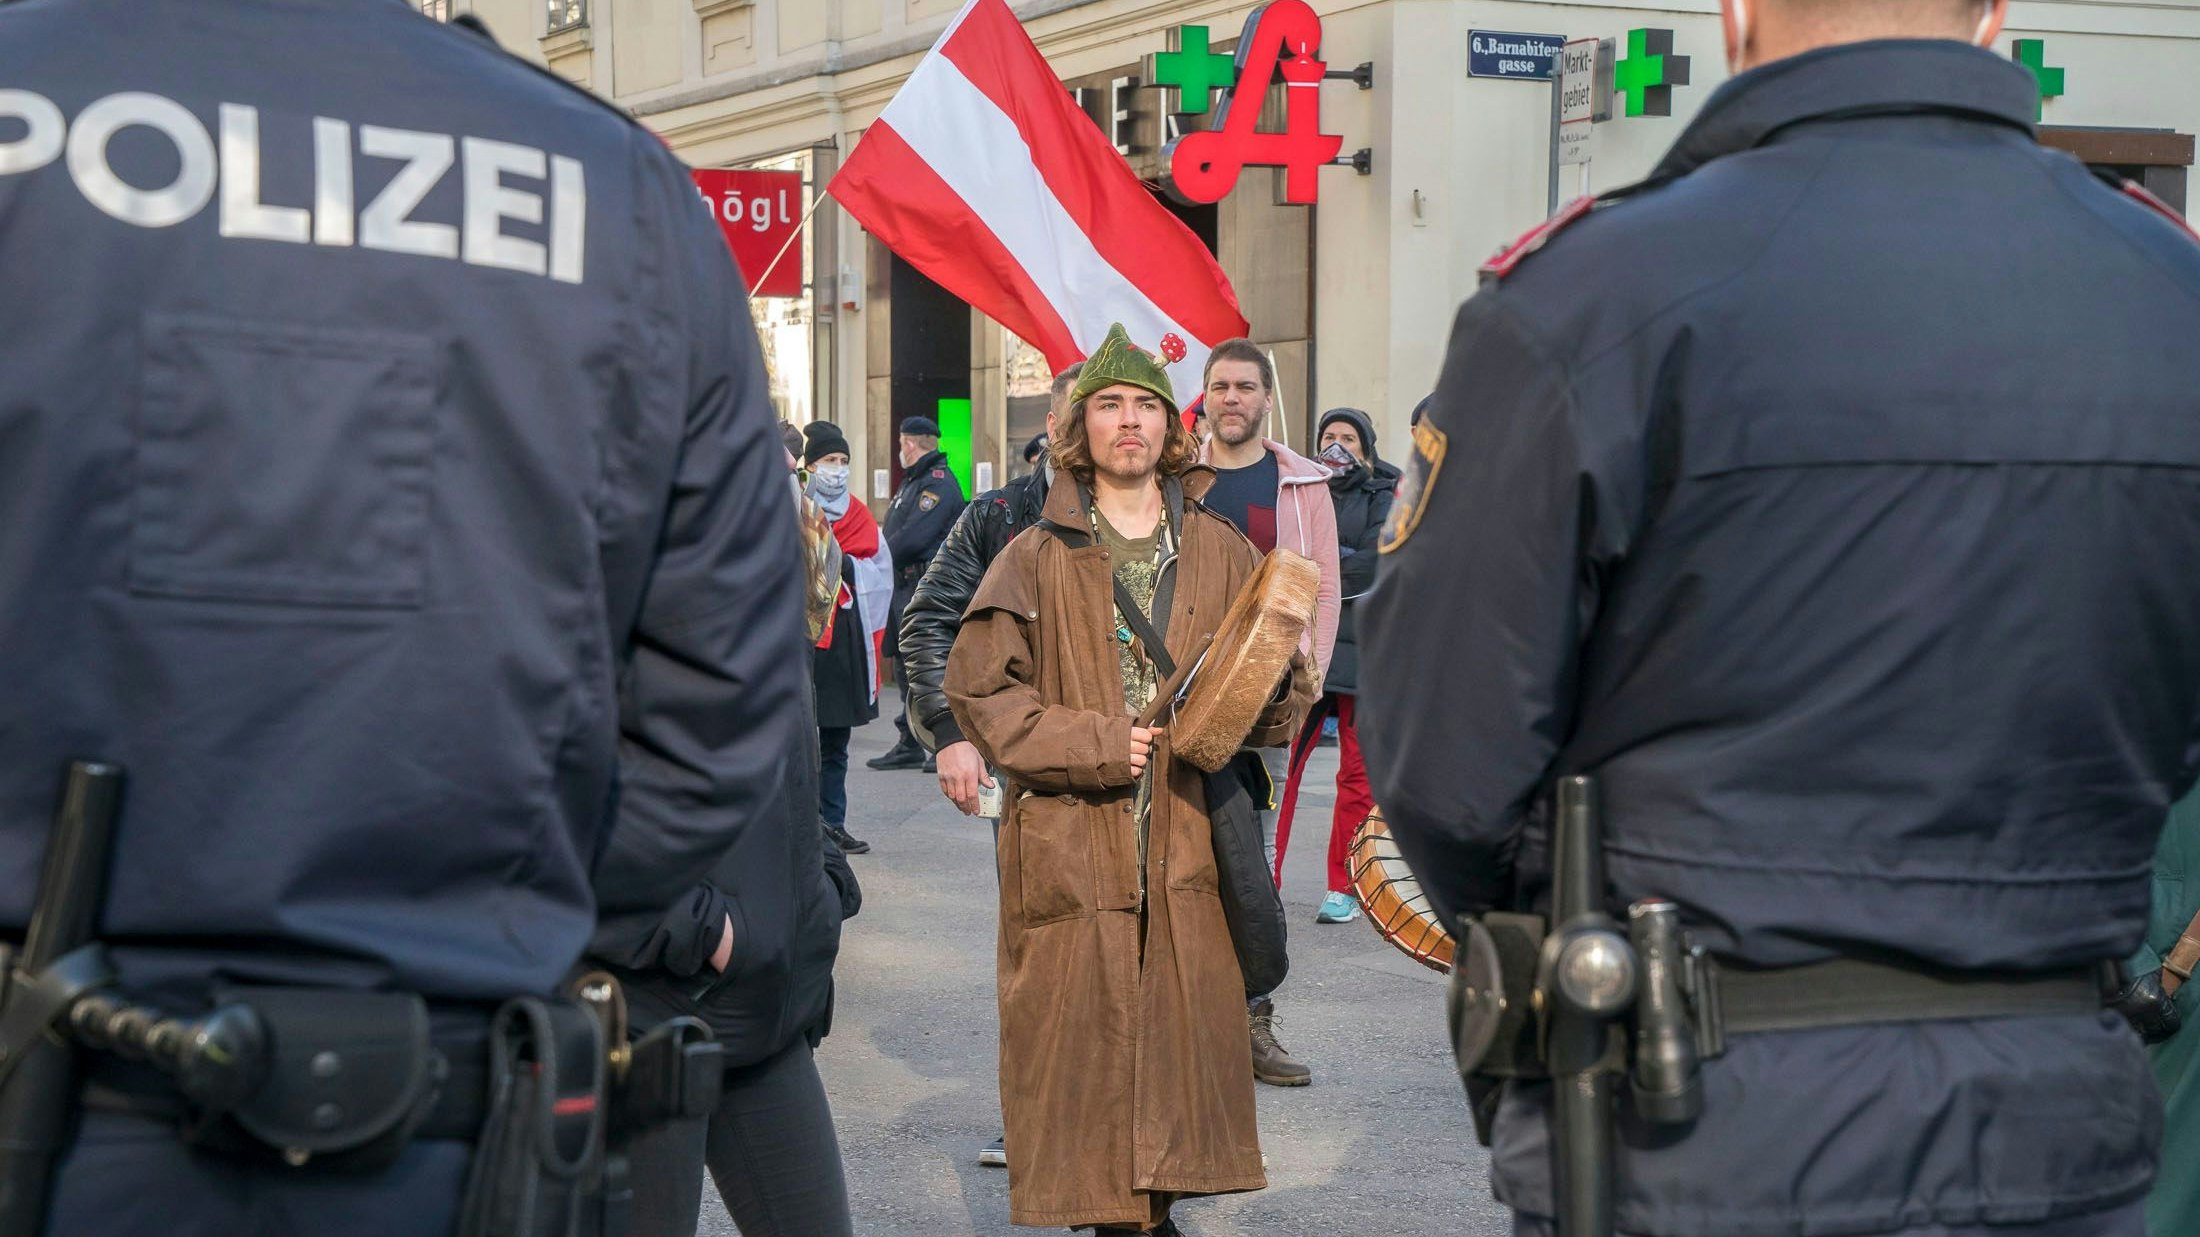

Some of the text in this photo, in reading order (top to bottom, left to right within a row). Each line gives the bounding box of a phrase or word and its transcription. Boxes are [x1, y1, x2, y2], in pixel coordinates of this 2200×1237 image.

[1498, 59, 1535, 74] gasse
[1564, 51, 1592, 75] Markt-
[1563, 82, 1590, 114] gebiet
